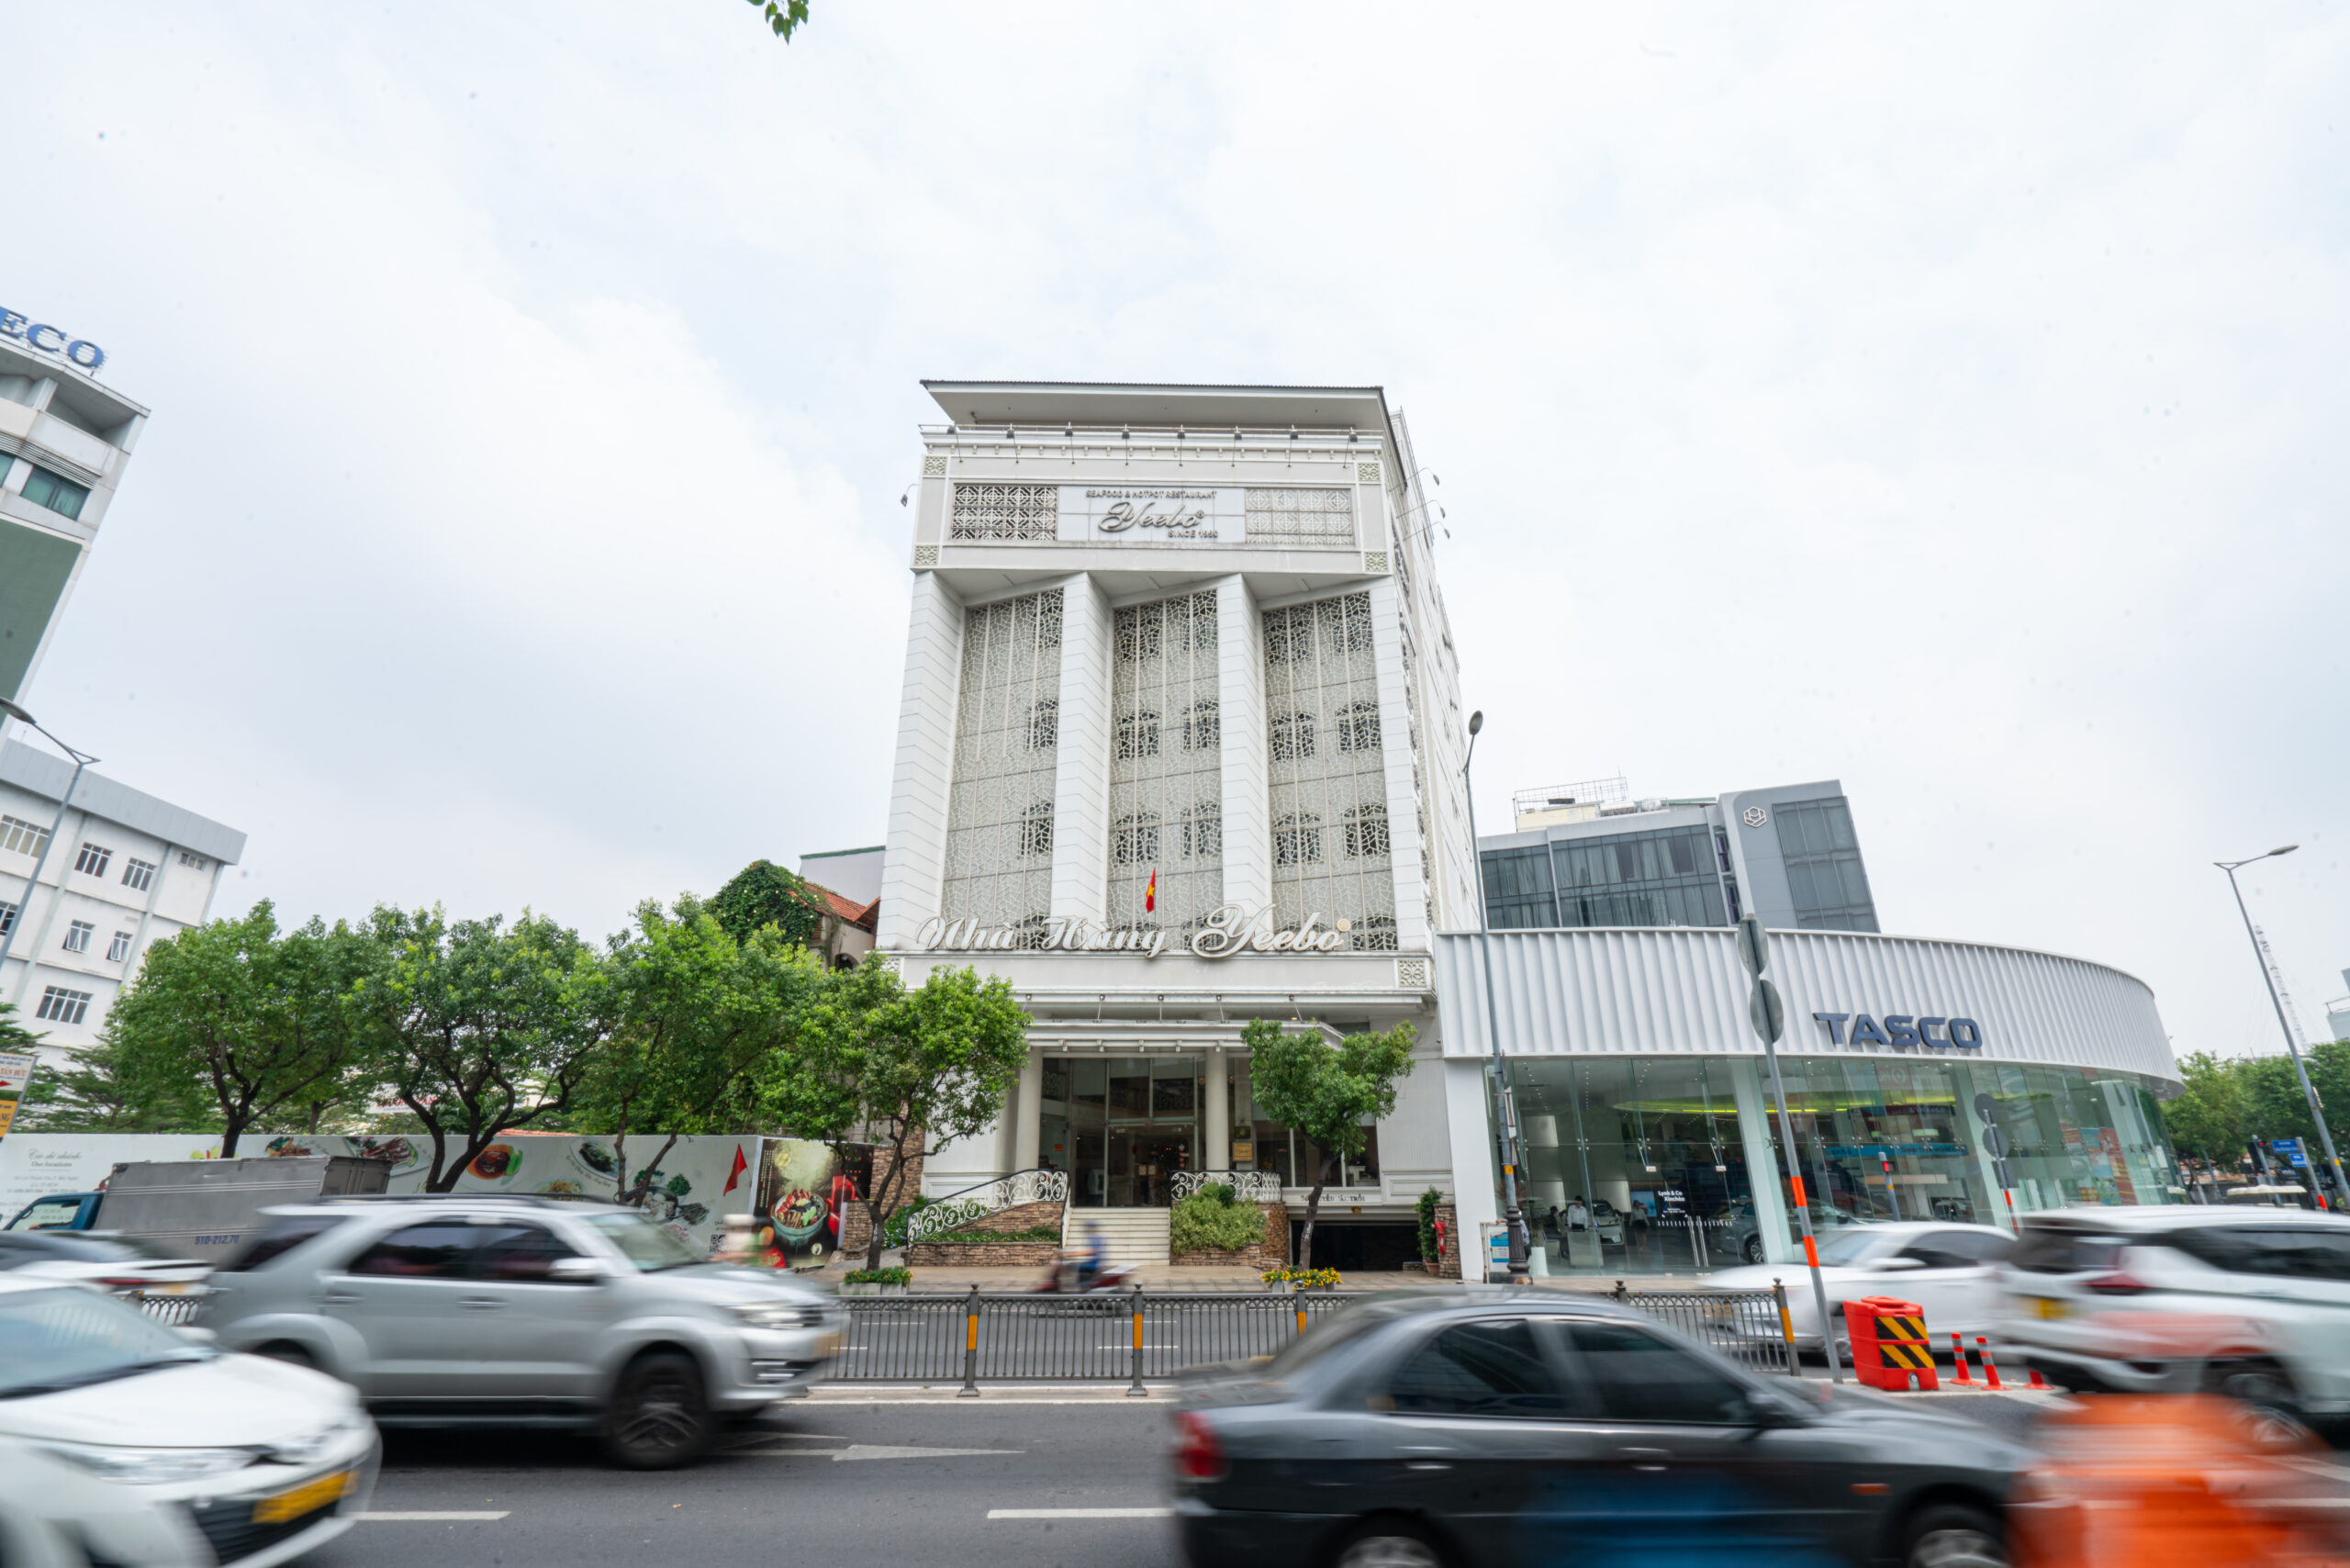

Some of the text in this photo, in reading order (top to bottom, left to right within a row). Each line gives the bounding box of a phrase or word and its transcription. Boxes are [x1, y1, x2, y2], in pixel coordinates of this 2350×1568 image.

[1085, 489, 1217, 499] SEAFOOD & HOTPOT RESTAURANT
[1168, 529, 1195, 539] SINCE
[916, 916, 1018, 951] Nhà
[1812, 1013, 1983, 1049] TASCO
